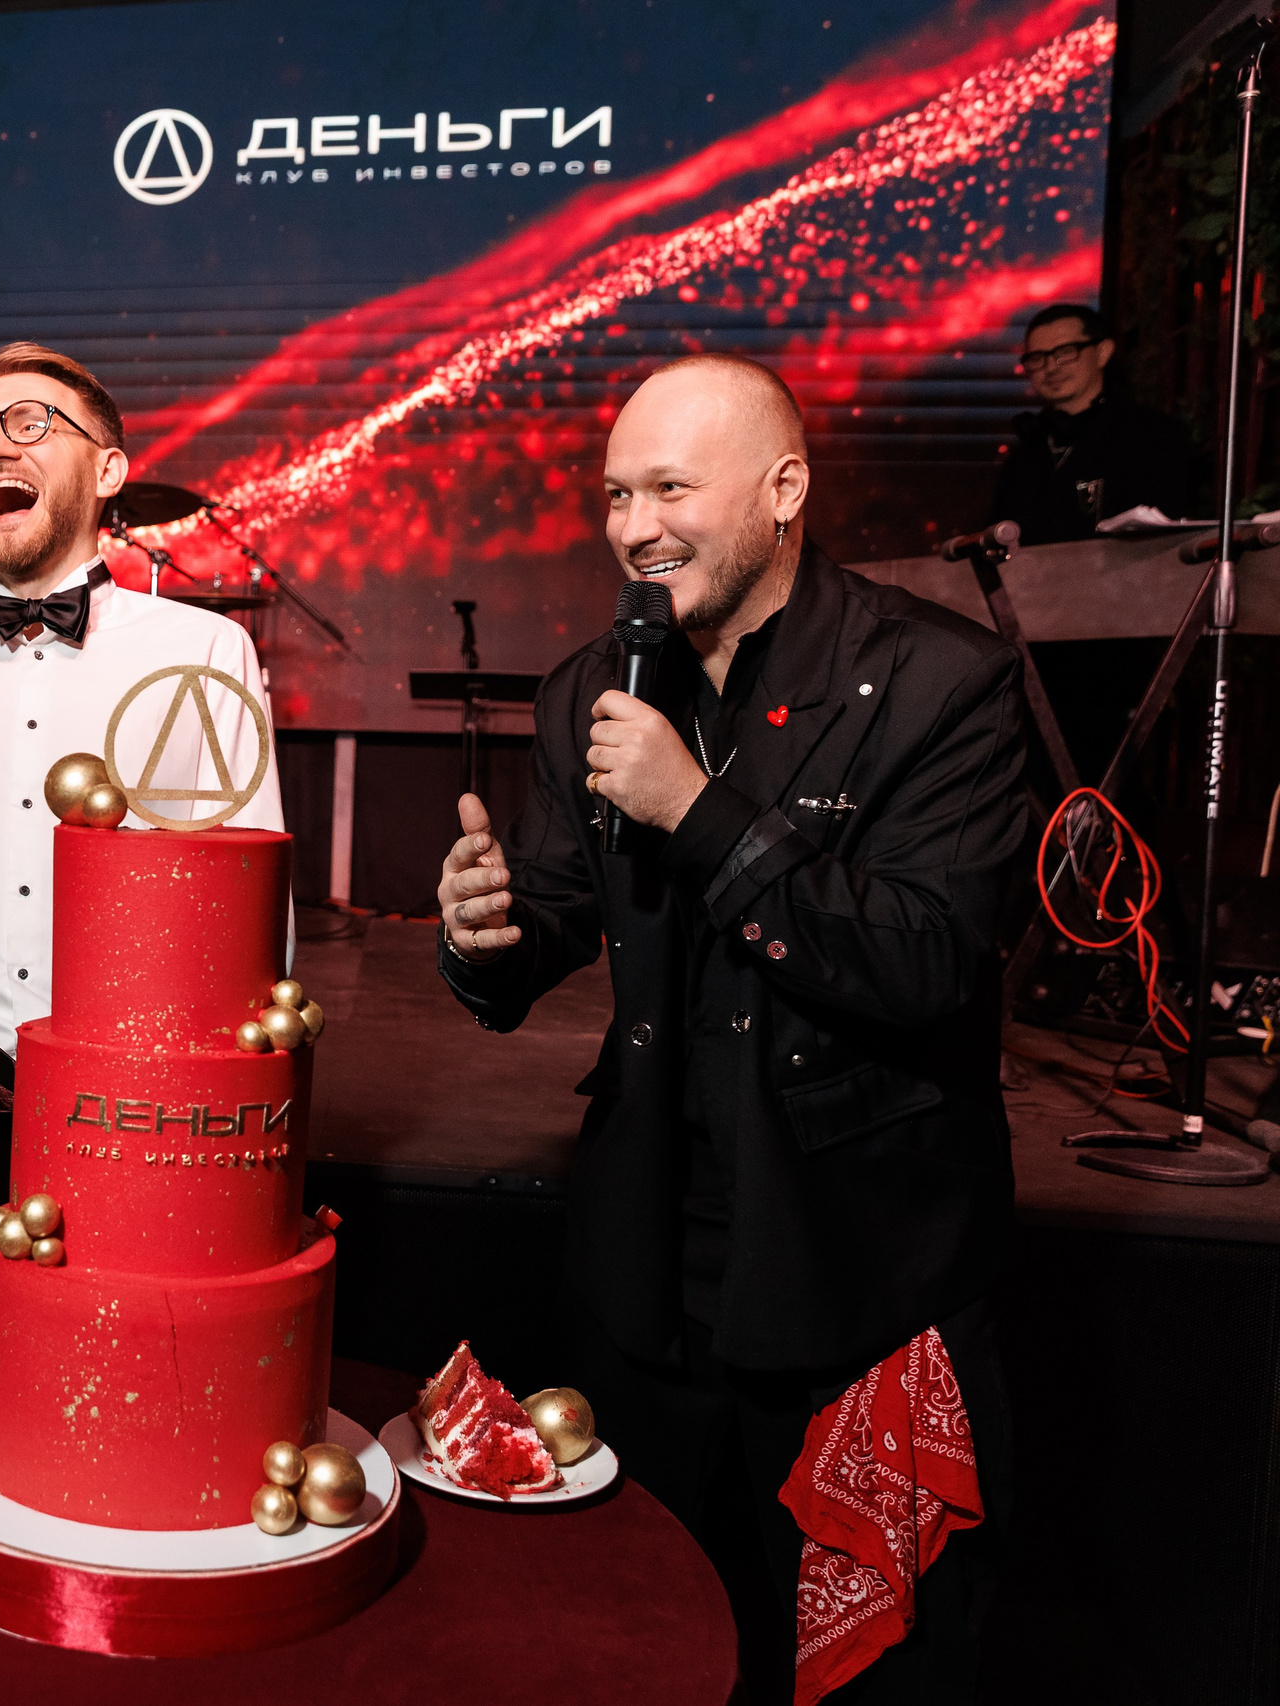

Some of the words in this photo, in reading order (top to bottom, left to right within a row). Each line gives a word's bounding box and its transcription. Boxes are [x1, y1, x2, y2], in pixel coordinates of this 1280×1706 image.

[236, 106, 613, 167] ДЕНЬГИ
[235, 168, 330, 185] КЛУБ
[355, 159, 613, 182] ИНВЕСТОРОВ
[1206, 679, 1229, 820] ULTIMATE
[66, 1091, 293, 1137] ДЕНЬГИ
